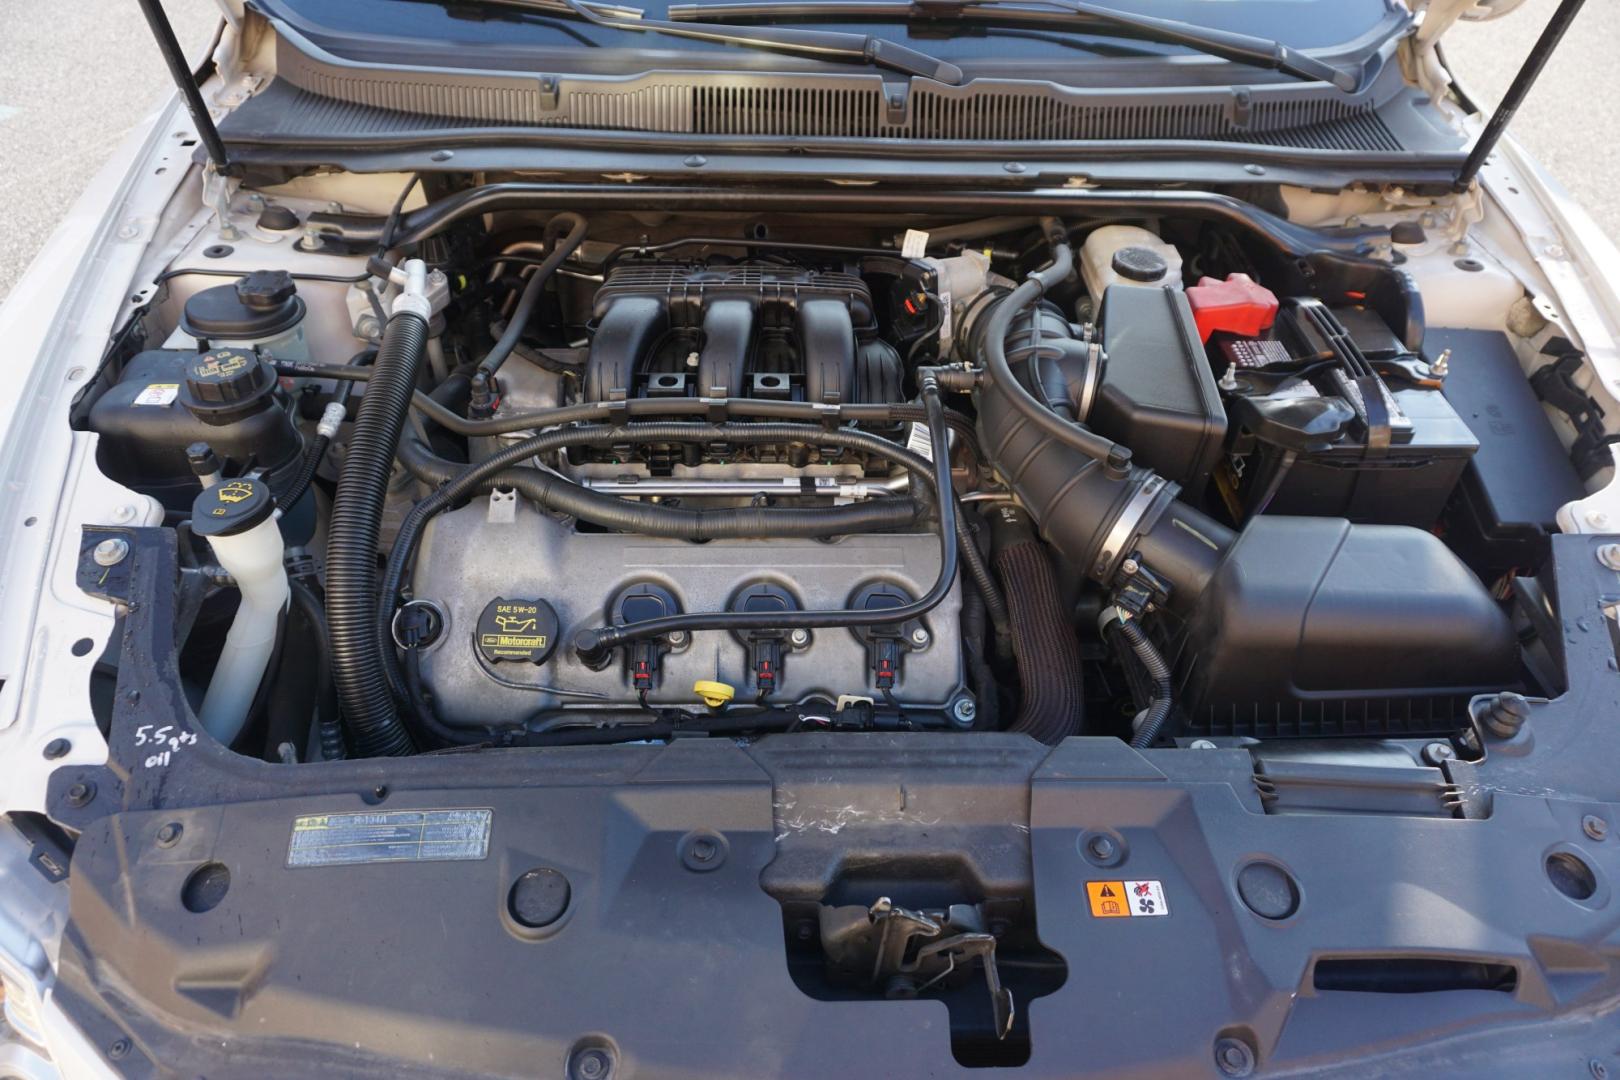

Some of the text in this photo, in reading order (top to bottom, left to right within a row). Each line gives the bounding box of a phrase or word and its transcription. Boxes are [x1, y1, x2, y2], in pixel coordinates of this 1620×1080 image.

[497, 605, 511, 613] SAE
[500, 636, 543, 646] Motorcraft
[144, 751, 171, 768] oil
